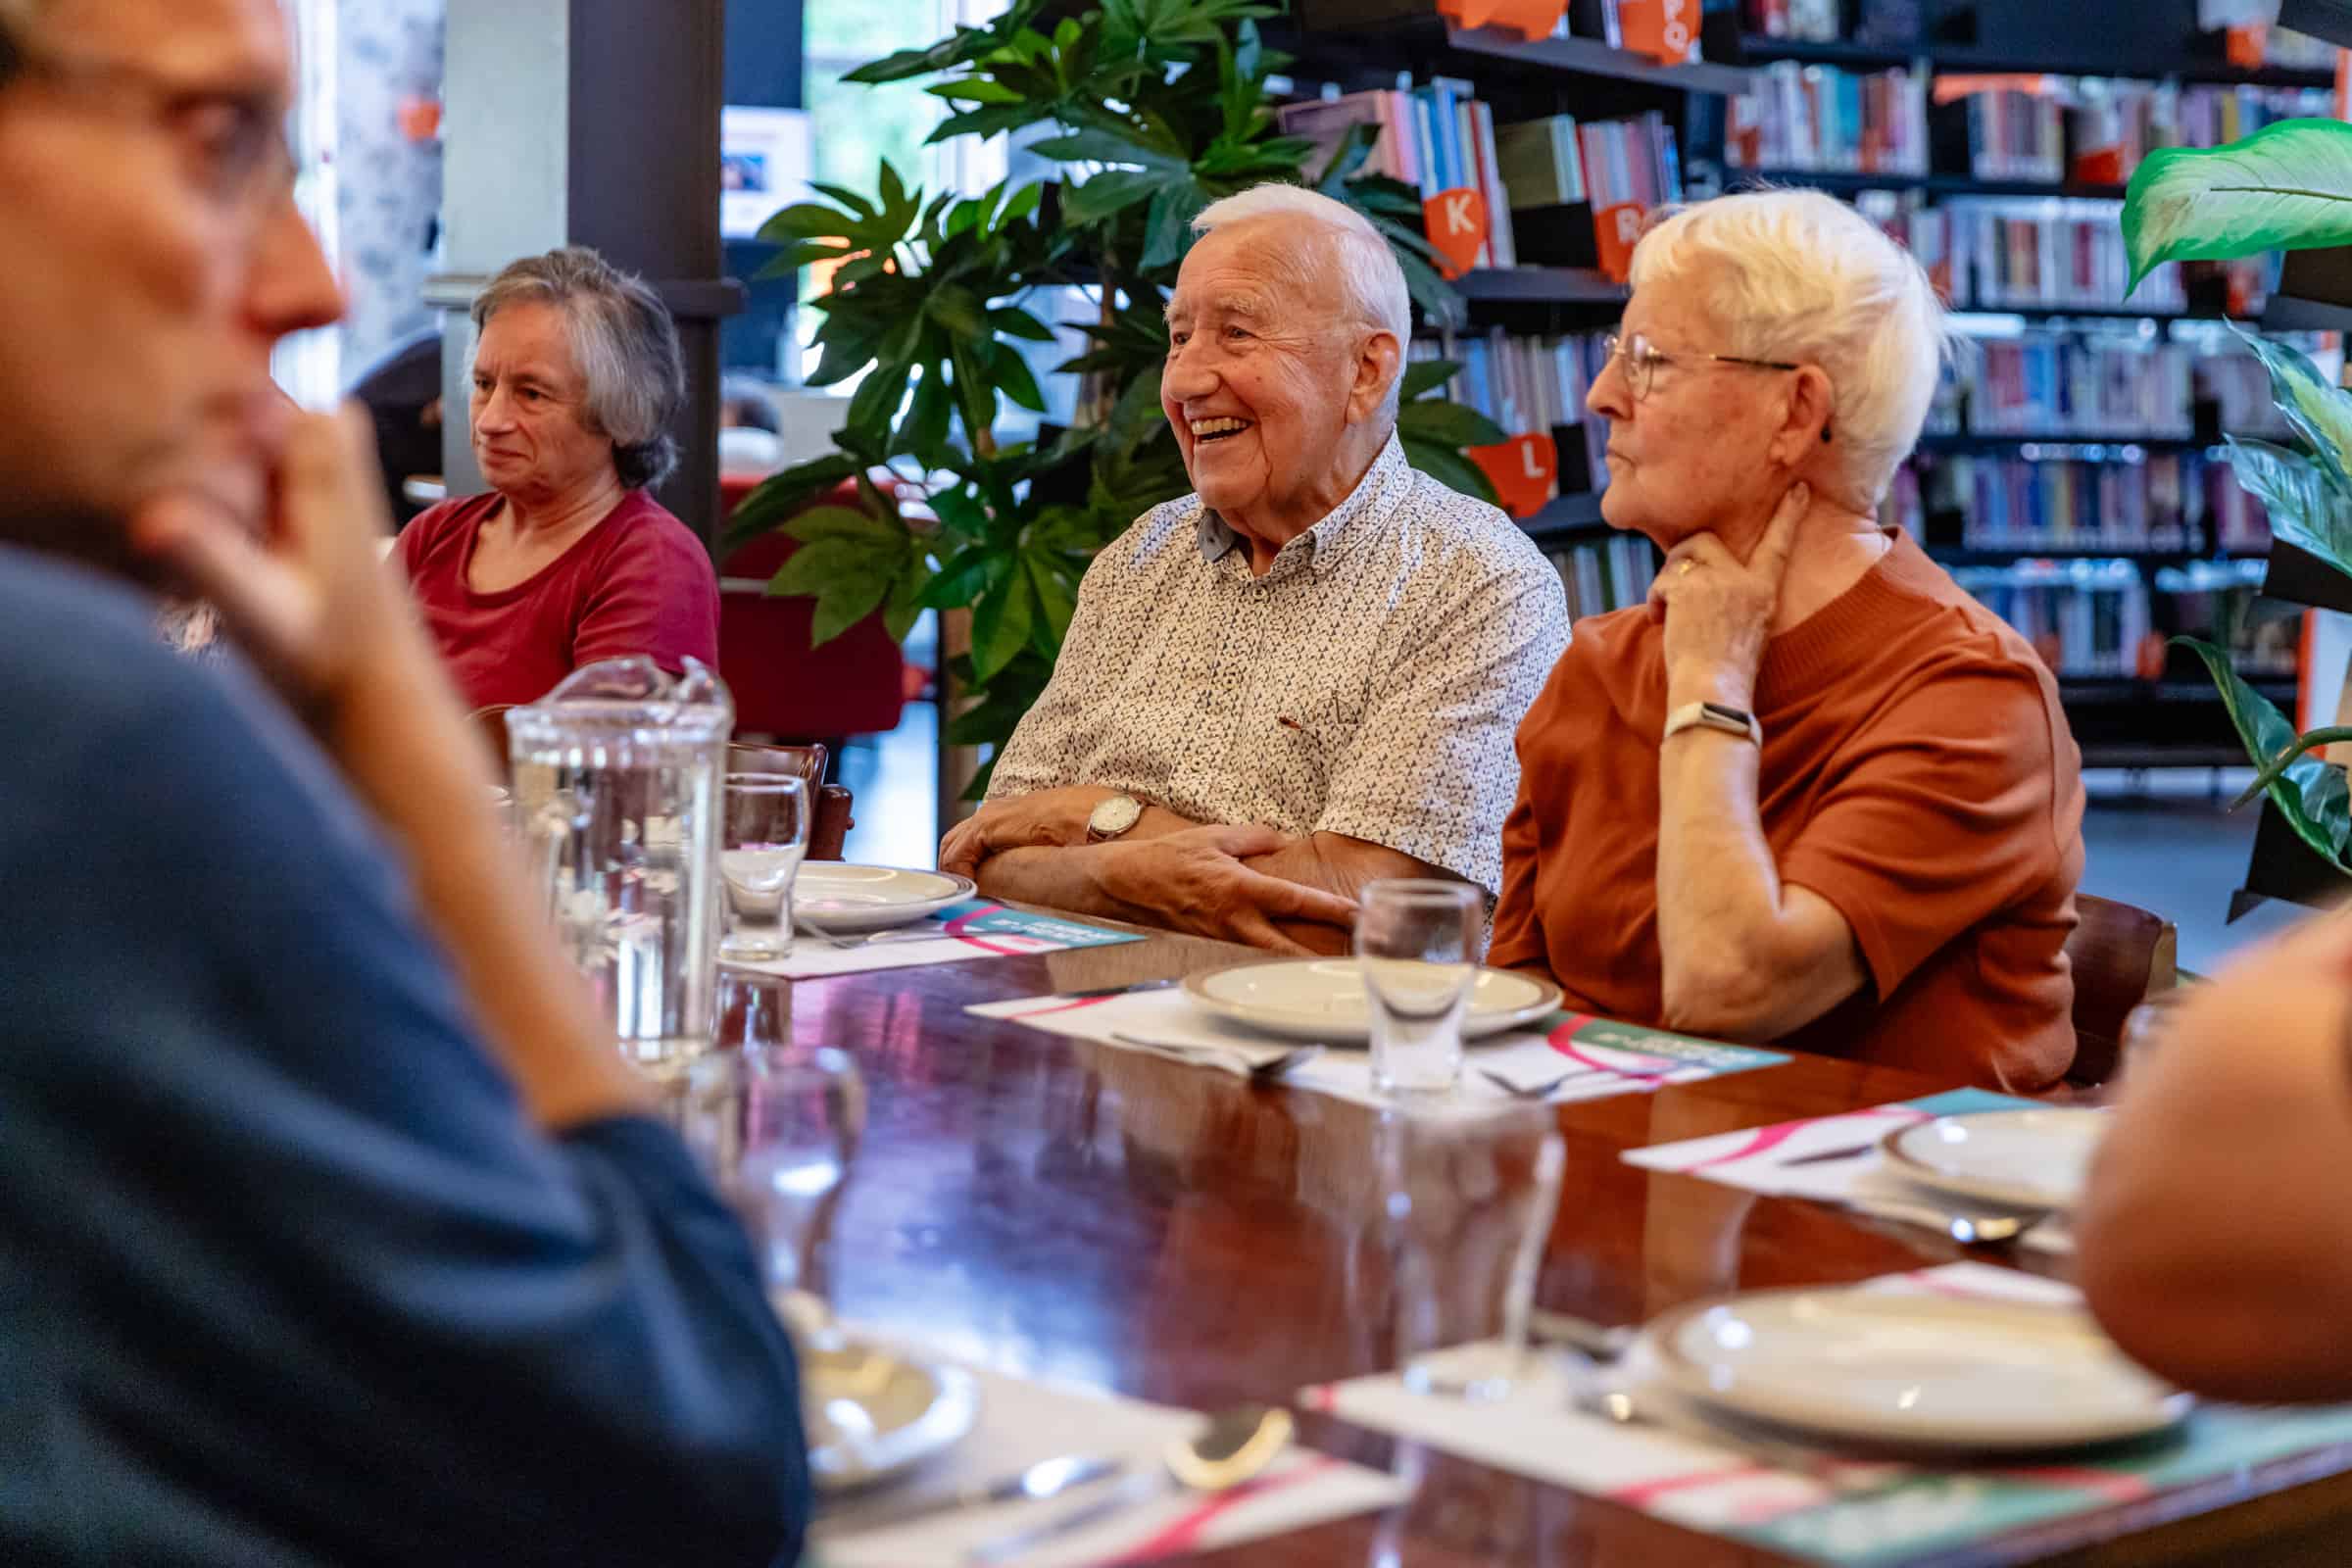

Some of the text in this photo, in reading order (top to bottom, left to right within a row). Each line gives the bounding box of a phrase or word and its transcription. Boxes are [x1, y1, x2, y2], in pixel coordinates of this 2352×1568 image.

[1446, 193, 1475, 235] K
[1616, 208, 1642, 245] R
[1521, 440, 1546, 478] L
